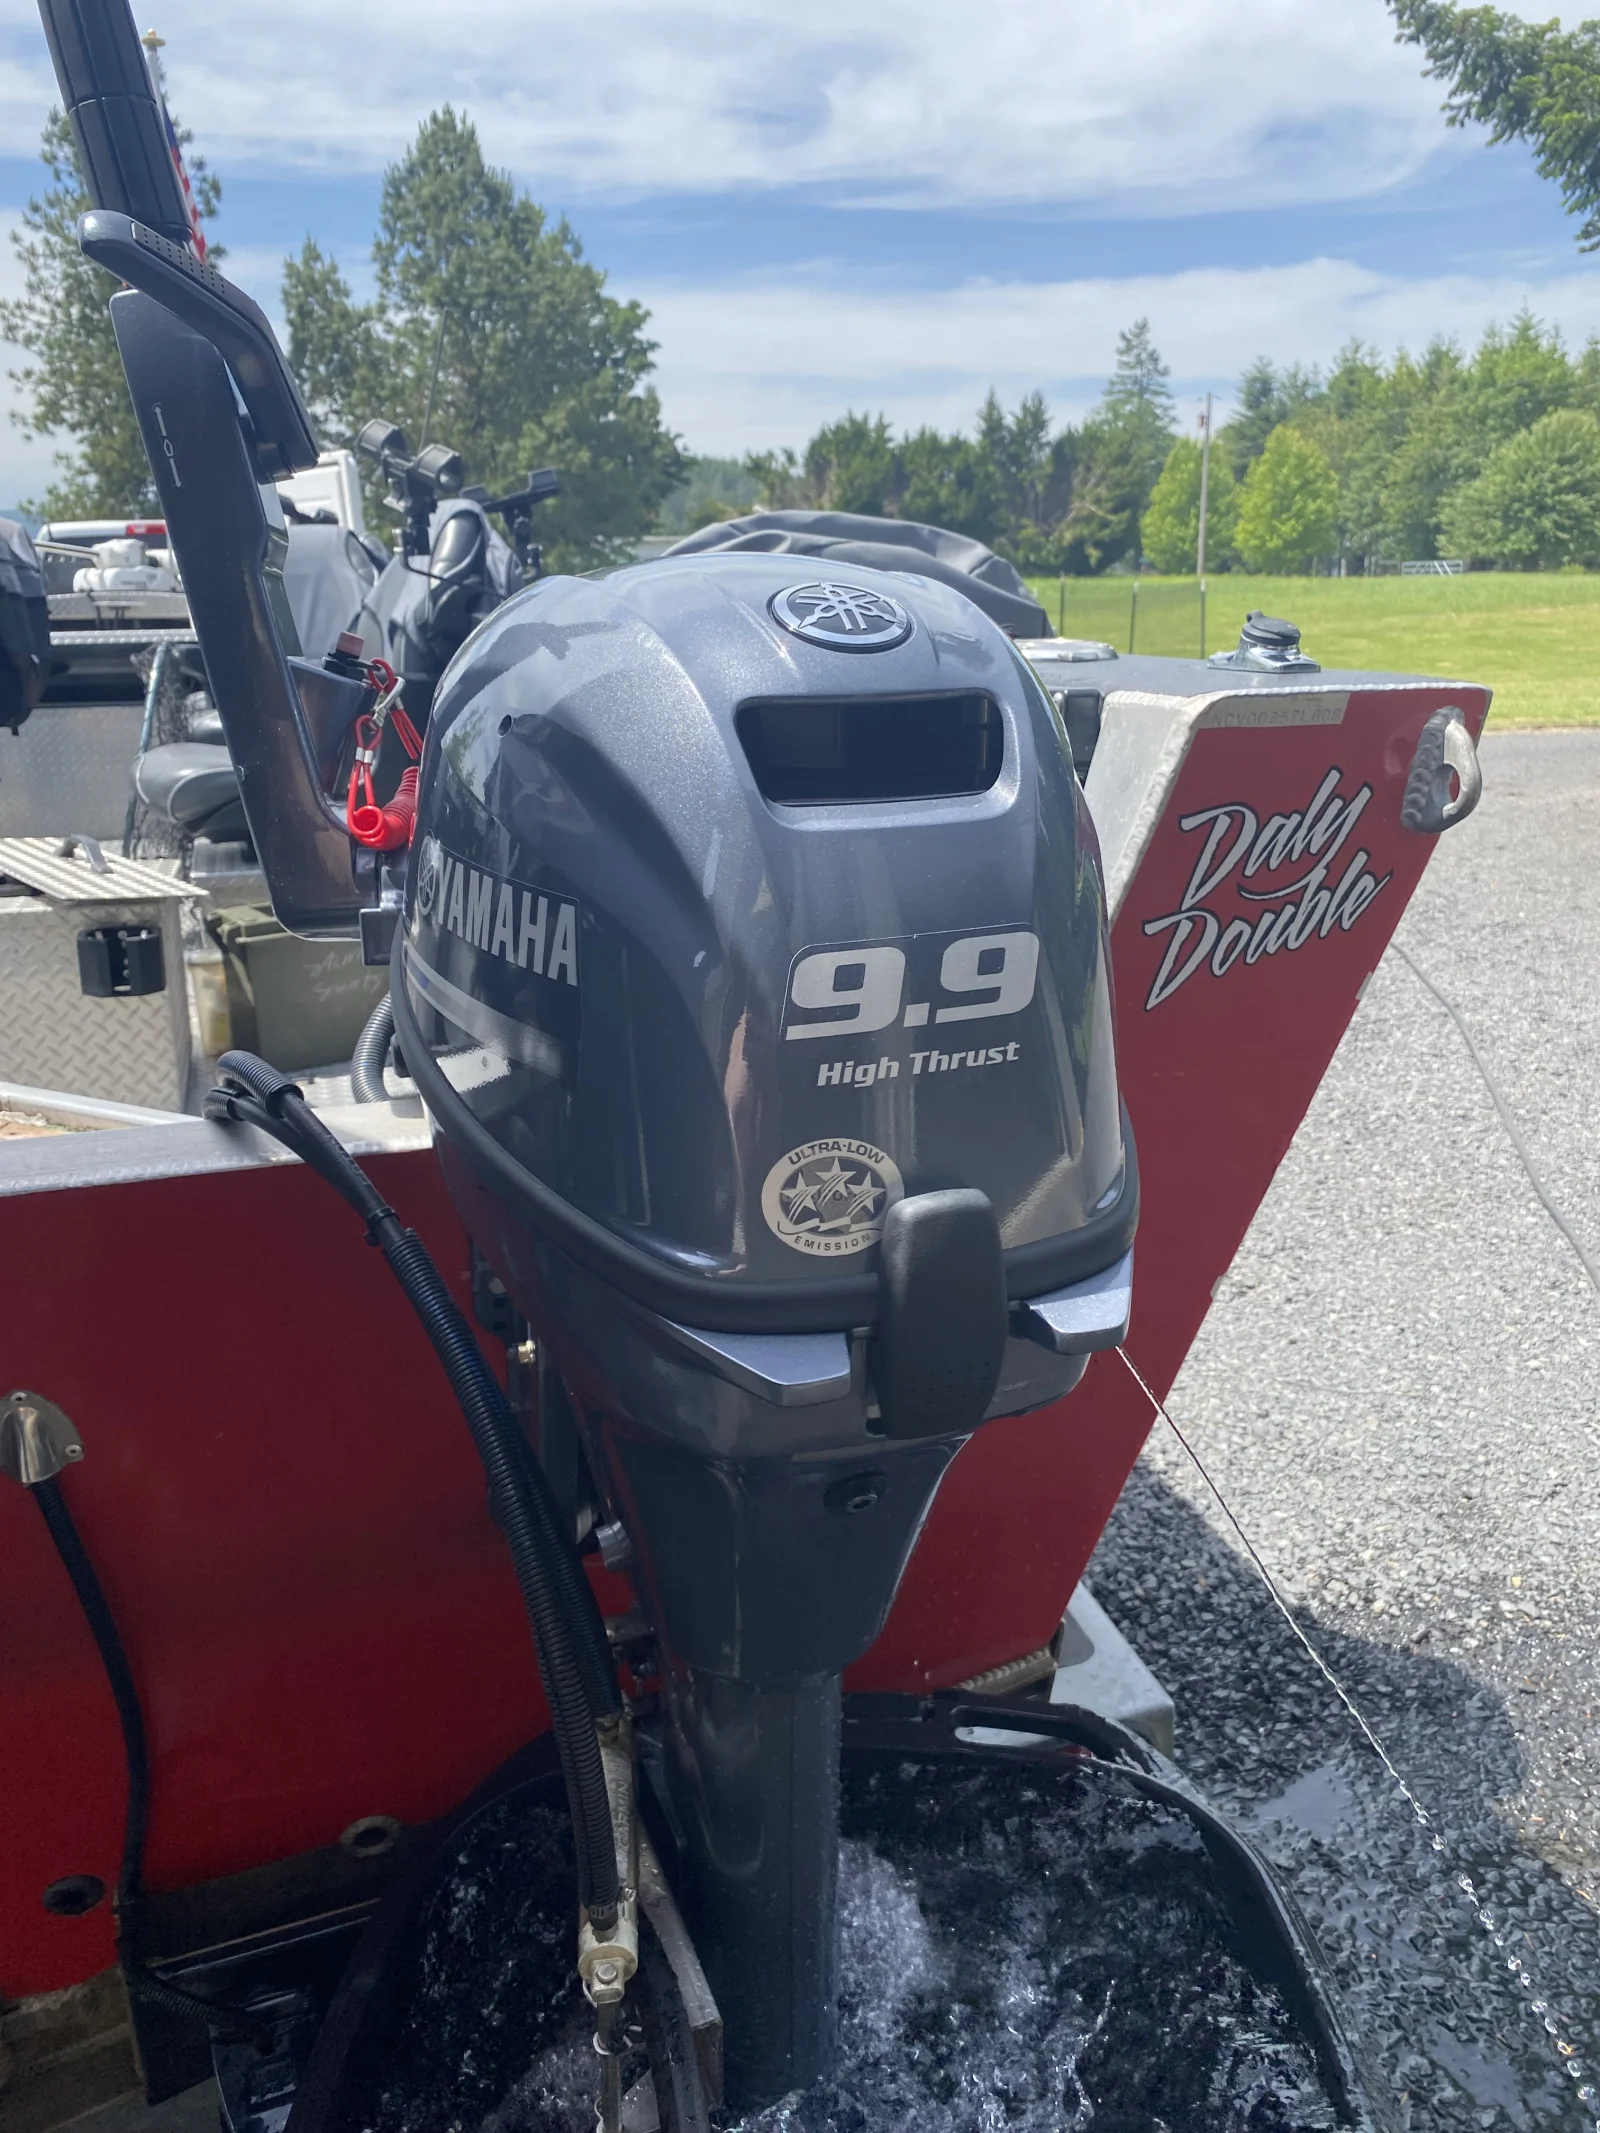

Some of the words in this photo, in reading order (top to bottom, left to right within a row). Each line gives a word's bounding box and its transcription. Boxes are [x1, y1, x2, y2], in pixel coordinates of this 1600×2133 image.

[1179, 765, 1374, 911] Daly
[437, 848, 578, 986] YAMAHA
[1142, 848, 1394, 1012] Double
[785, 931, 1040, 1041] 9.9
[816, 1056, 900, 1088] High
[909, 1041, 1021, 1076] Thrust
[793, 1232, 871, 1251] EMISSION
